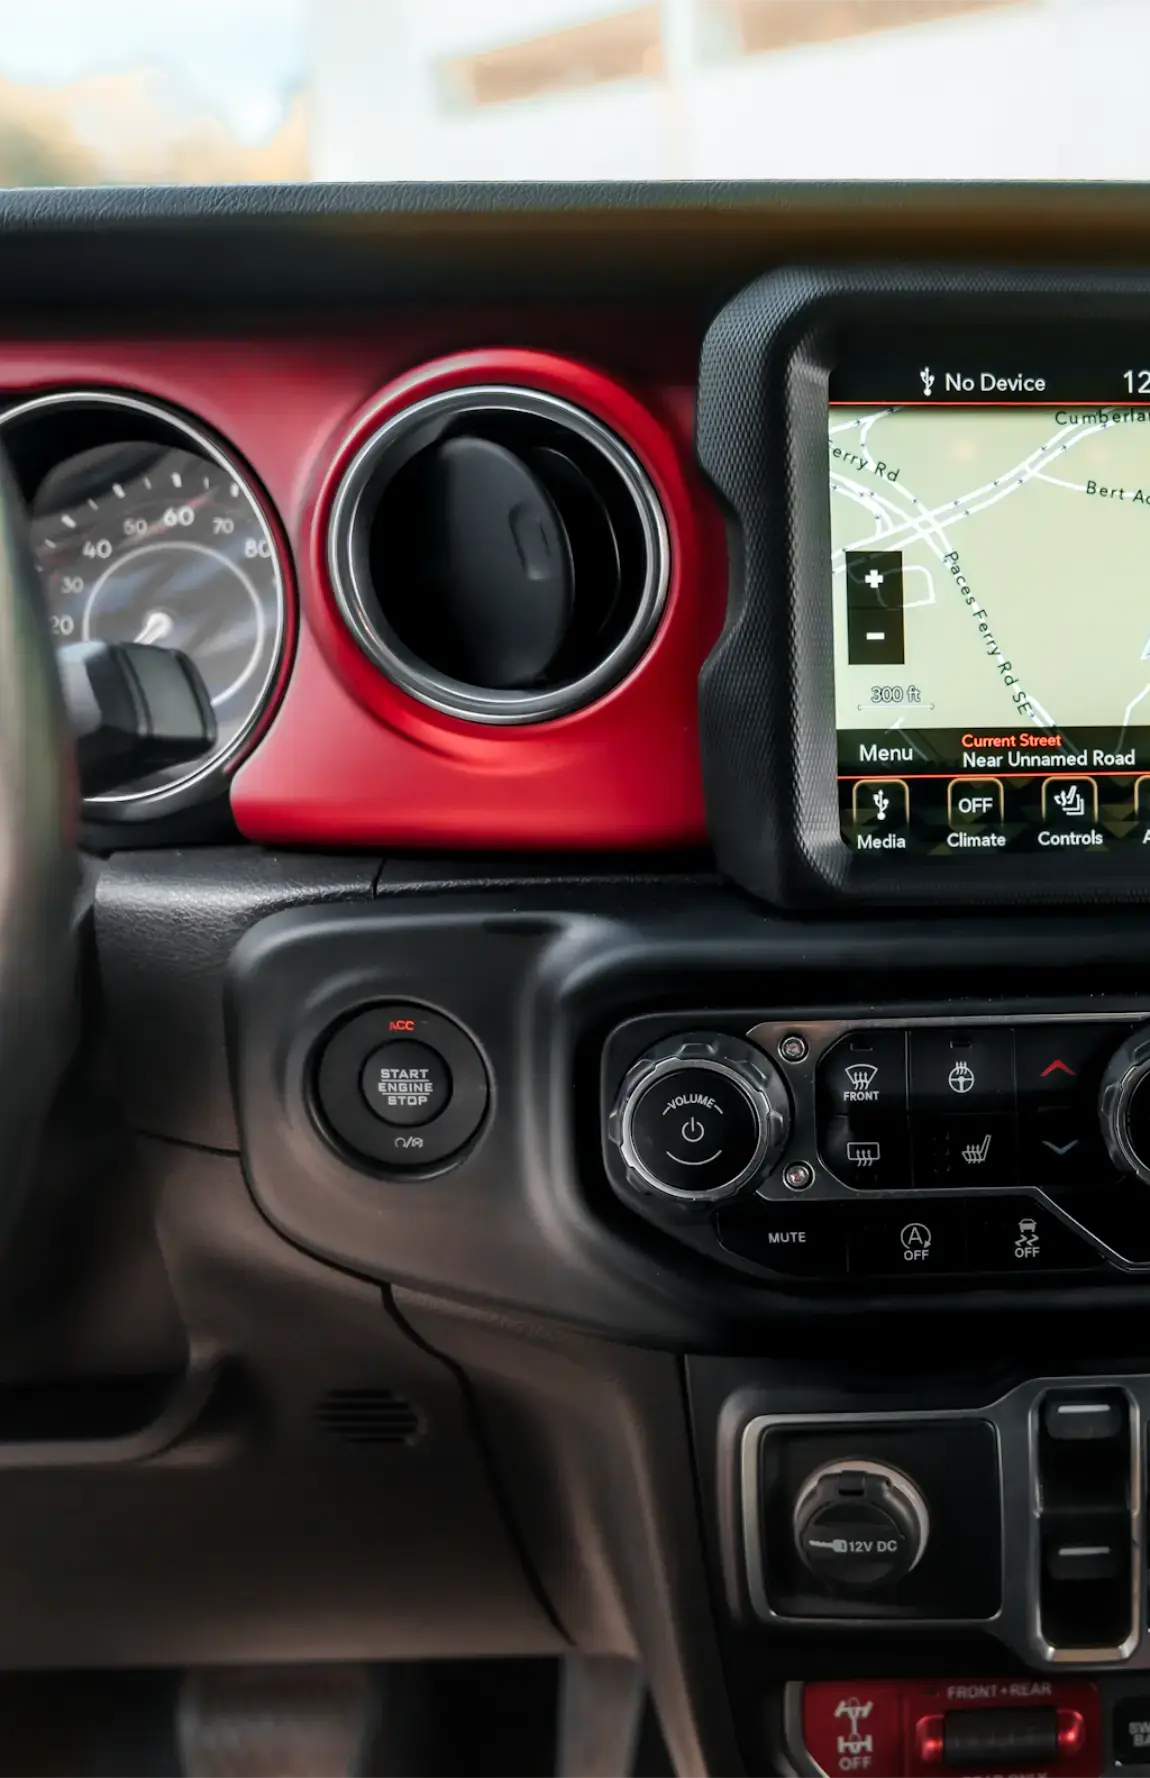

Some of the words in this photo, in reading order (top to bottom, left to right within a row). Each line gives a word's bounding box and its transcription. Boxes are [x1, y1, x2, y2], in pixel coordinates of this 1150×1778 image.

[945, 373, 975, 392] No
[981, 372, 1046, 392] Device
[874, 461, 900, 482] Rd
[1086, 480, 1125, 500] Bert
[163, 505, 194, 526] 60
[123, 518, 147, 535] 50
[212, 517, 234, 534] 70
[82, 539, 112, 559] 40
[244, 539, 272, 558] 80
[61, 577, 83, 593] 30
[944, 551, 975, 606] Paces
[973, 609, 1001, 657] Ferry
[997, 661, 1019, 686] Rd
[1012, 691, 1032, 715] SE
[871, 687, 903, 703] 300
[907, 685, 921, 703] ft
[962, 734, 1016, 748] Current
[1019, 733, 1062, 747] Street
[859, 744, 913, 762] Menu
[962, 751, 1003, 768] Near
[1008, 750, 1088, 767] Unnamed
[1093, 749, 1136, 766] Road
[958, 798, 993, 813] OFF
[857, 834, 906, 849] Media
[947, 832, 1006, 848] Climate
[1037, 830, 1103, 846] Controls
[389, 1020, 416, 1031] ACC
[380, 1069, 429, 1079] START
[378, 1082, 433, 1092] ENGINE
[387, 1096, 428, 1106] STOP
[667, 1094, 716, 1110] VOLUME
[843, 1091, 879, 1101] FRONT
[768, 1232, 806, 1243] MUTE
[903, 1250, 929, 1261] OFF
[1015, 1247, 1040, 1258] OFF
[849, 1541, 873, 1552] 12V
[877, 1540, 897, 1551] DC
[838, 1756, 871, 1771] OFF
